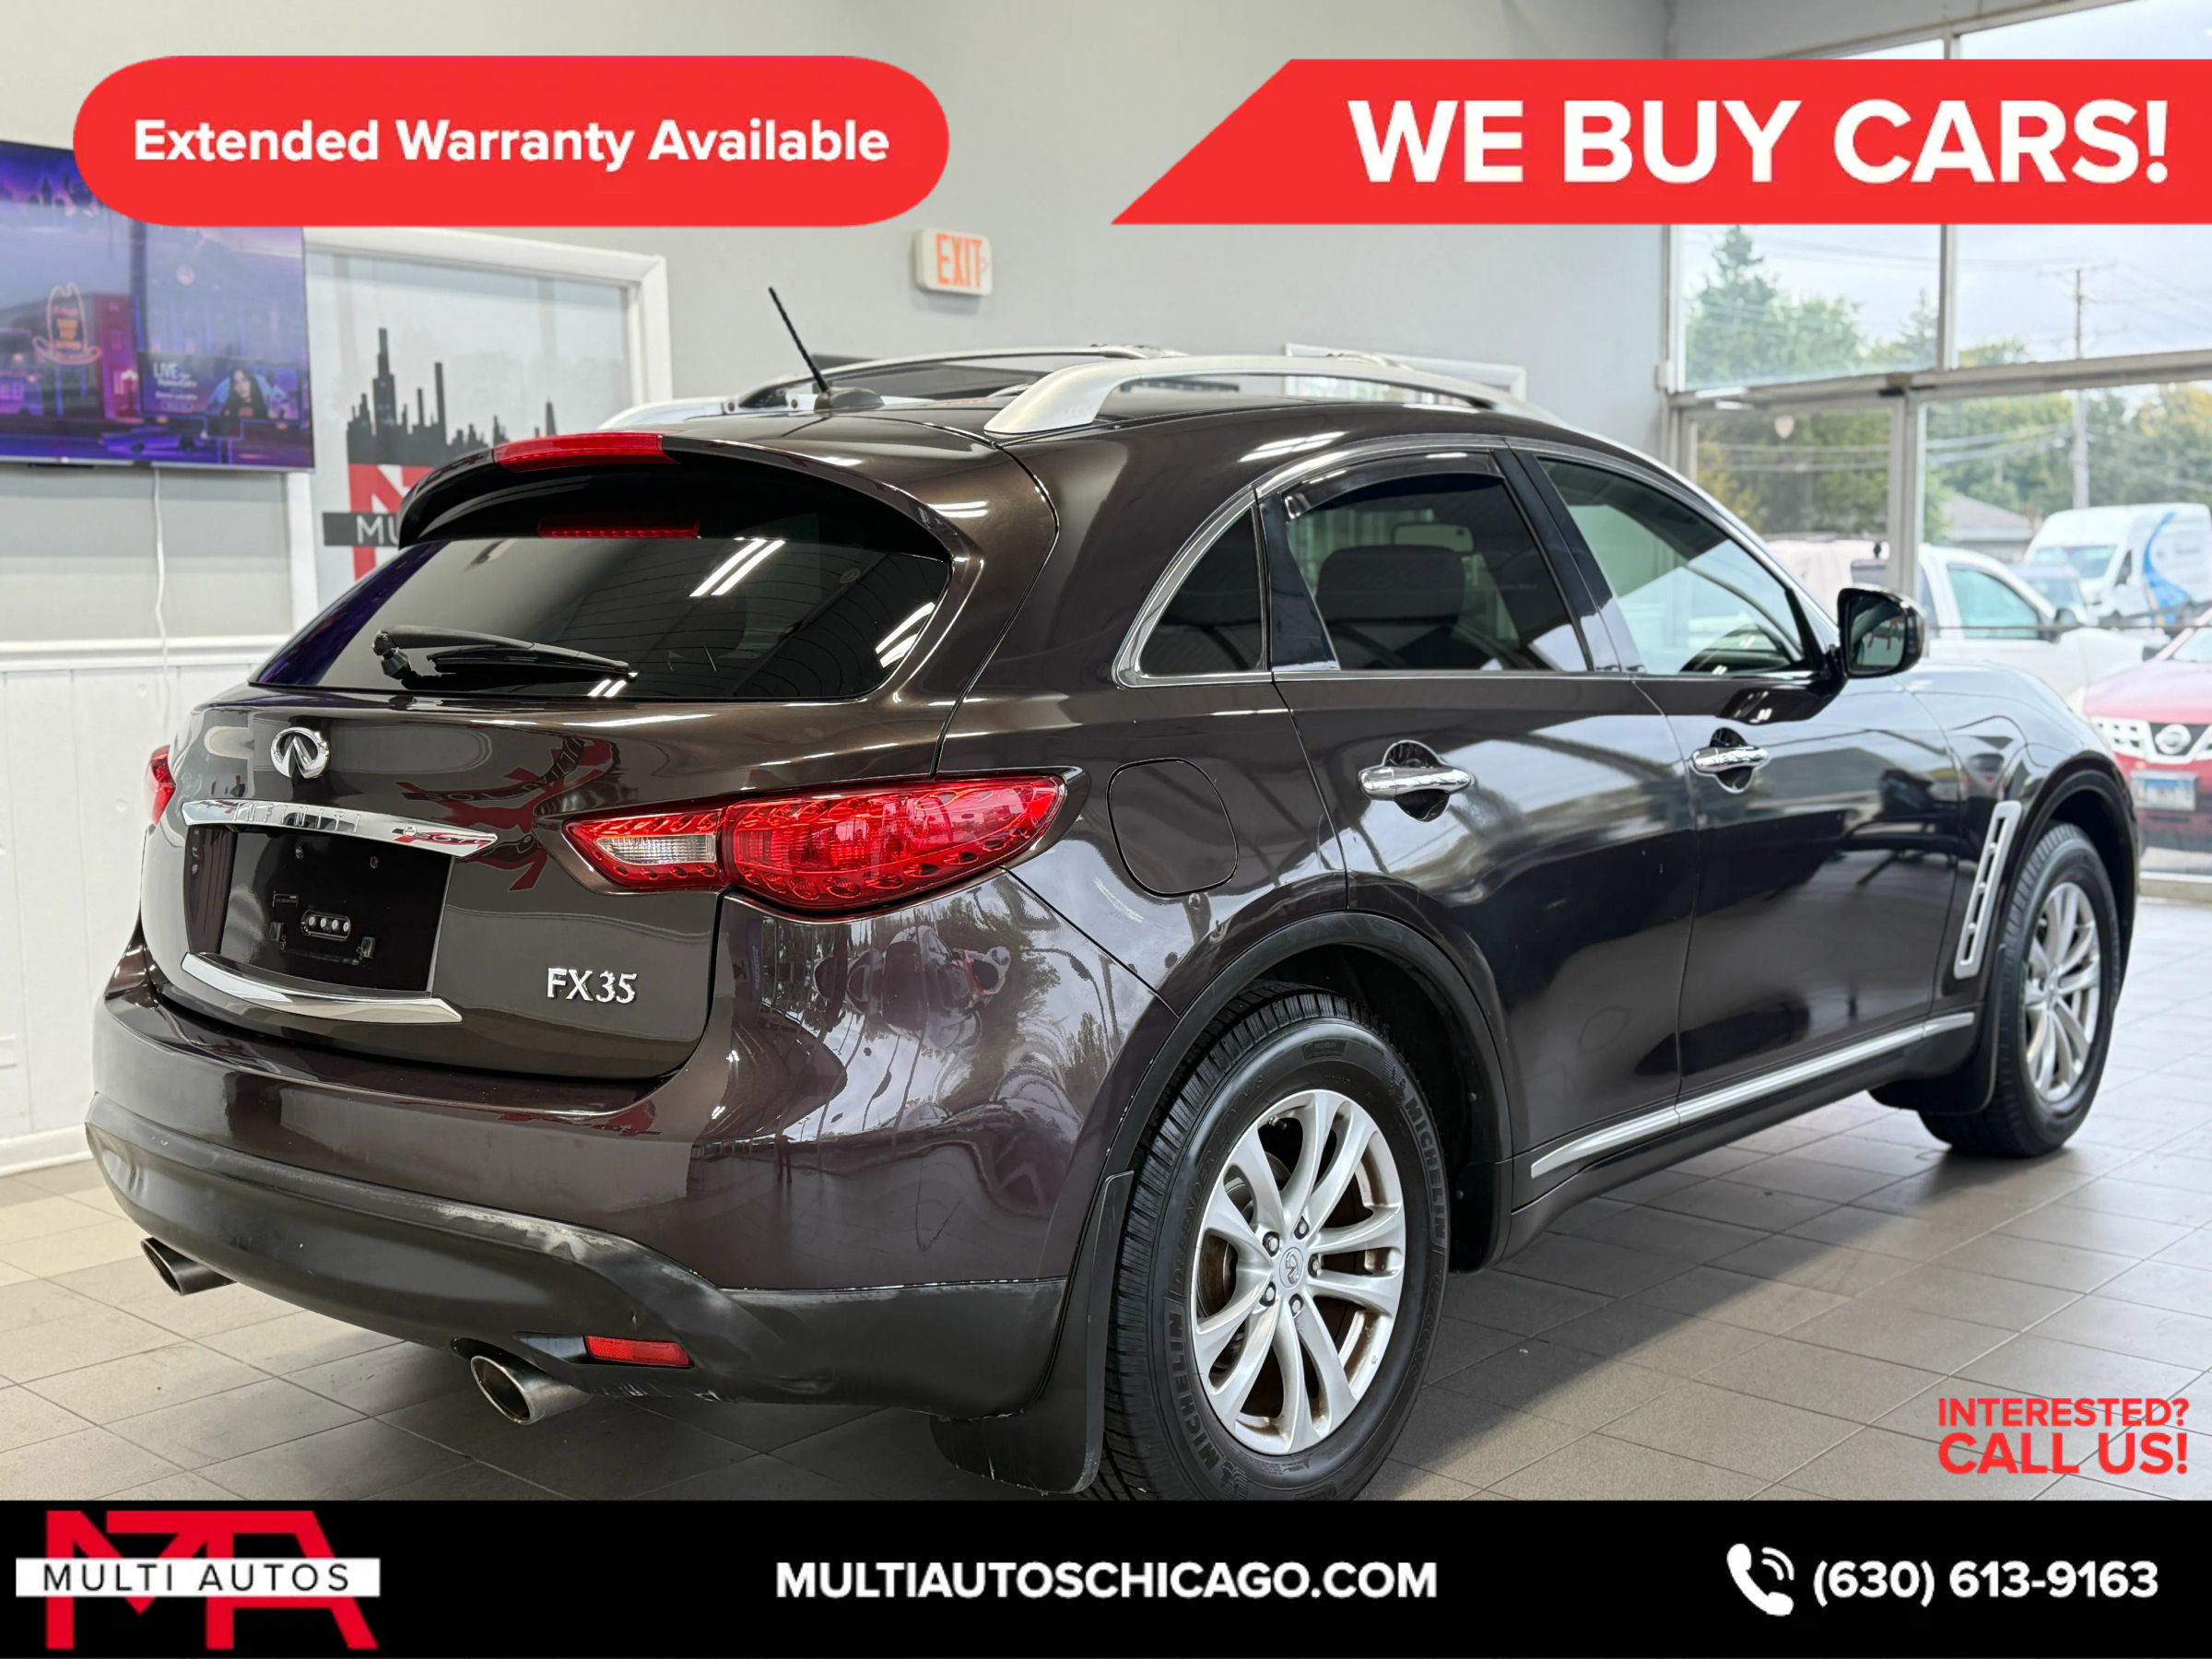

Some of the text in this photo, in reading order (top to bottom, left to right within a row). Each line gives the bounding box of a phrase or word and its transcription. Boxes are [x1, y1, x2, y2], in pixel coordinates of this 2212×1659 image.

[935, 233, 982, 288] EXIT
[233, 801, 362, 834] INFINITI
[1404, 1096, 1446, 1240] MICHELIN
[1168, 1312, 1220, 1472] MICHELIN
